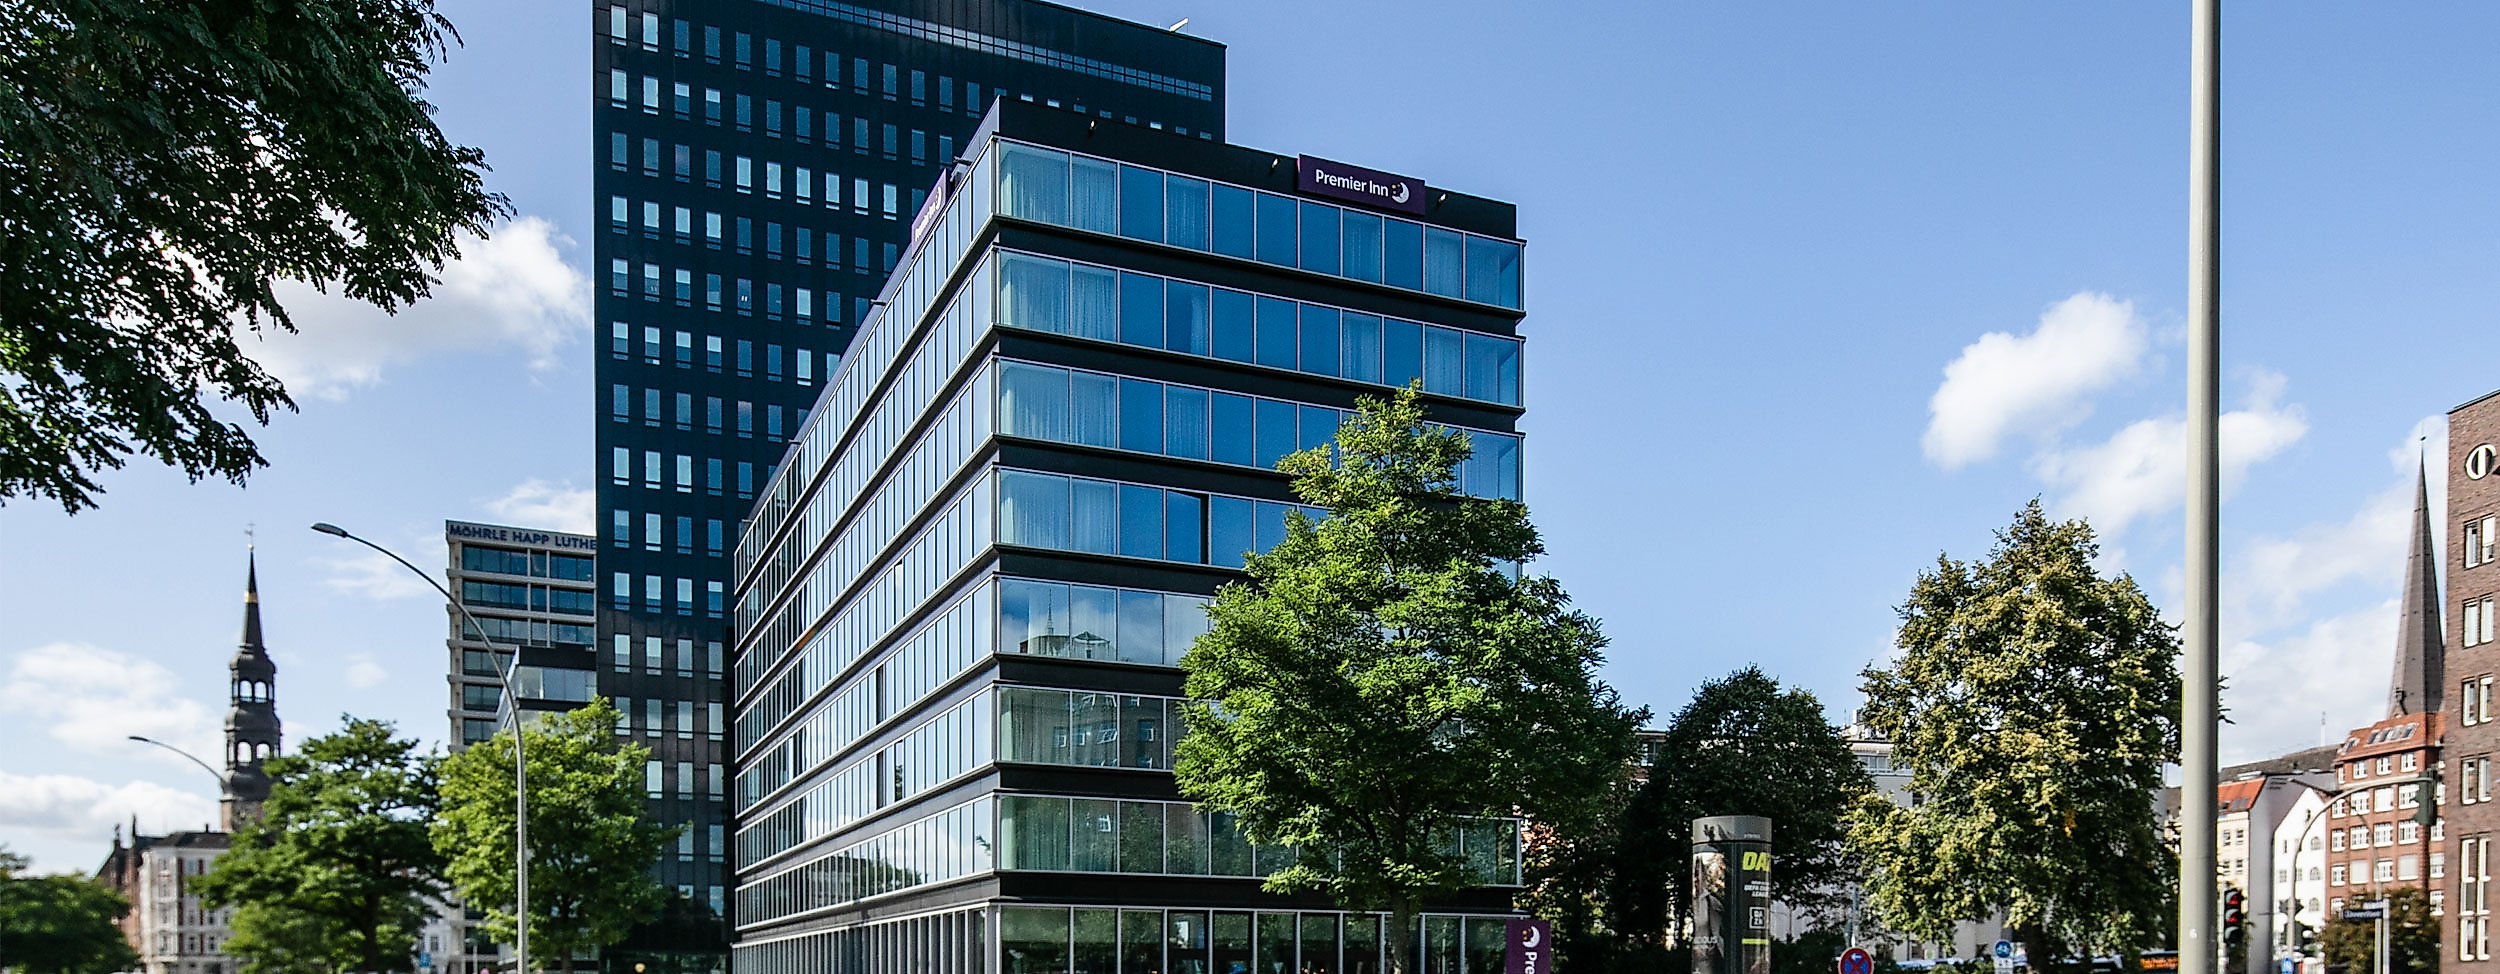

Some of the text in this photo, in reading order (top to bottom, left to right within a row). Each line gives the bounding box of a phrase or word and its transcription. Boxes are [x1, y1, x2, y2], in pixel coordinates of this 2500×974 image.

[1316, 169, 1389, 197] Premier Inn
[513, 531, 549, 544] HAPP
[1525, 952, 1537, 974] Pre
